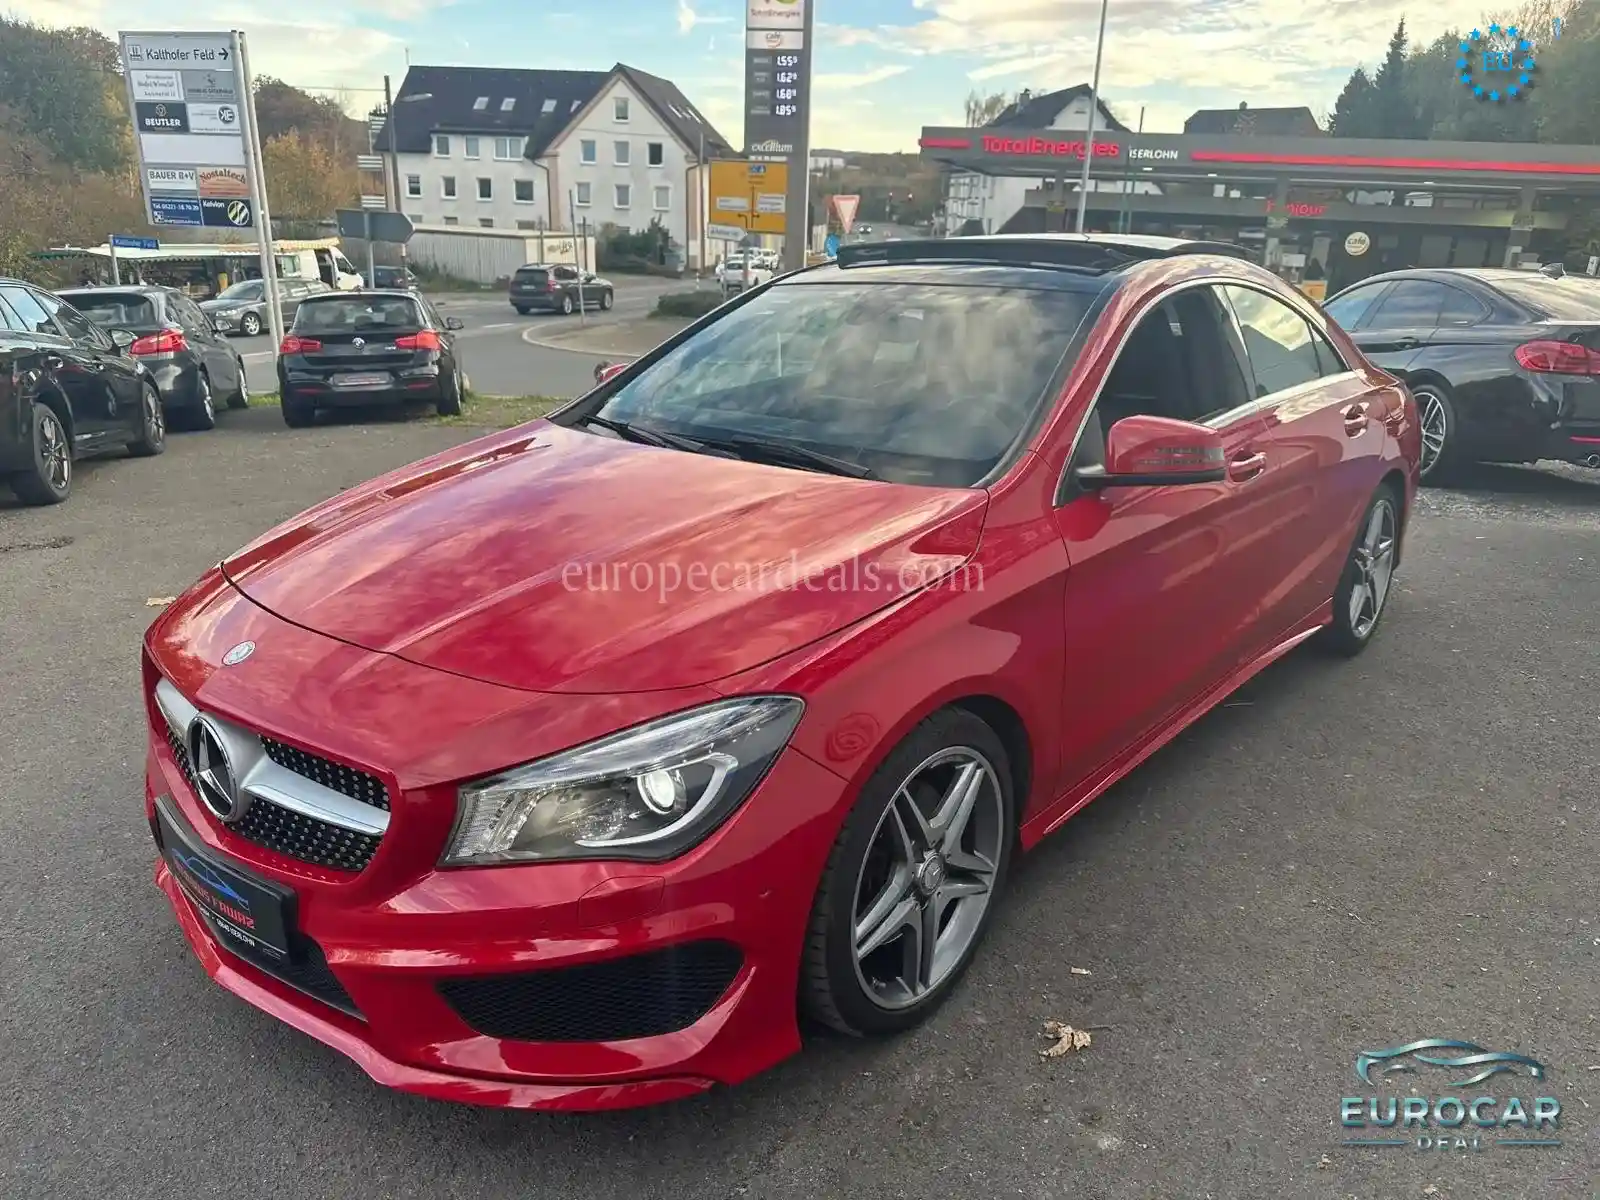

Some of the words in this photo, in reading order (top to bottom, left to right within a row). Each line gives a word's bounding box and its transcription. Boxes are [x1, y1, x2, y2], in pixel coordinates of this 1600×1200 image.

[146, 48, 190, 60] Kalthofer
[193, 49, 215, 60] Feld
[144, 118, 181, 127] BEUTLER
[982, 134, 1119, 160] TotalEnergies
[149, 170, 177, 180] BAUER
[200, 169, 246, 184] Nostaltech
[202, 200, 226, 208] Kelvion
